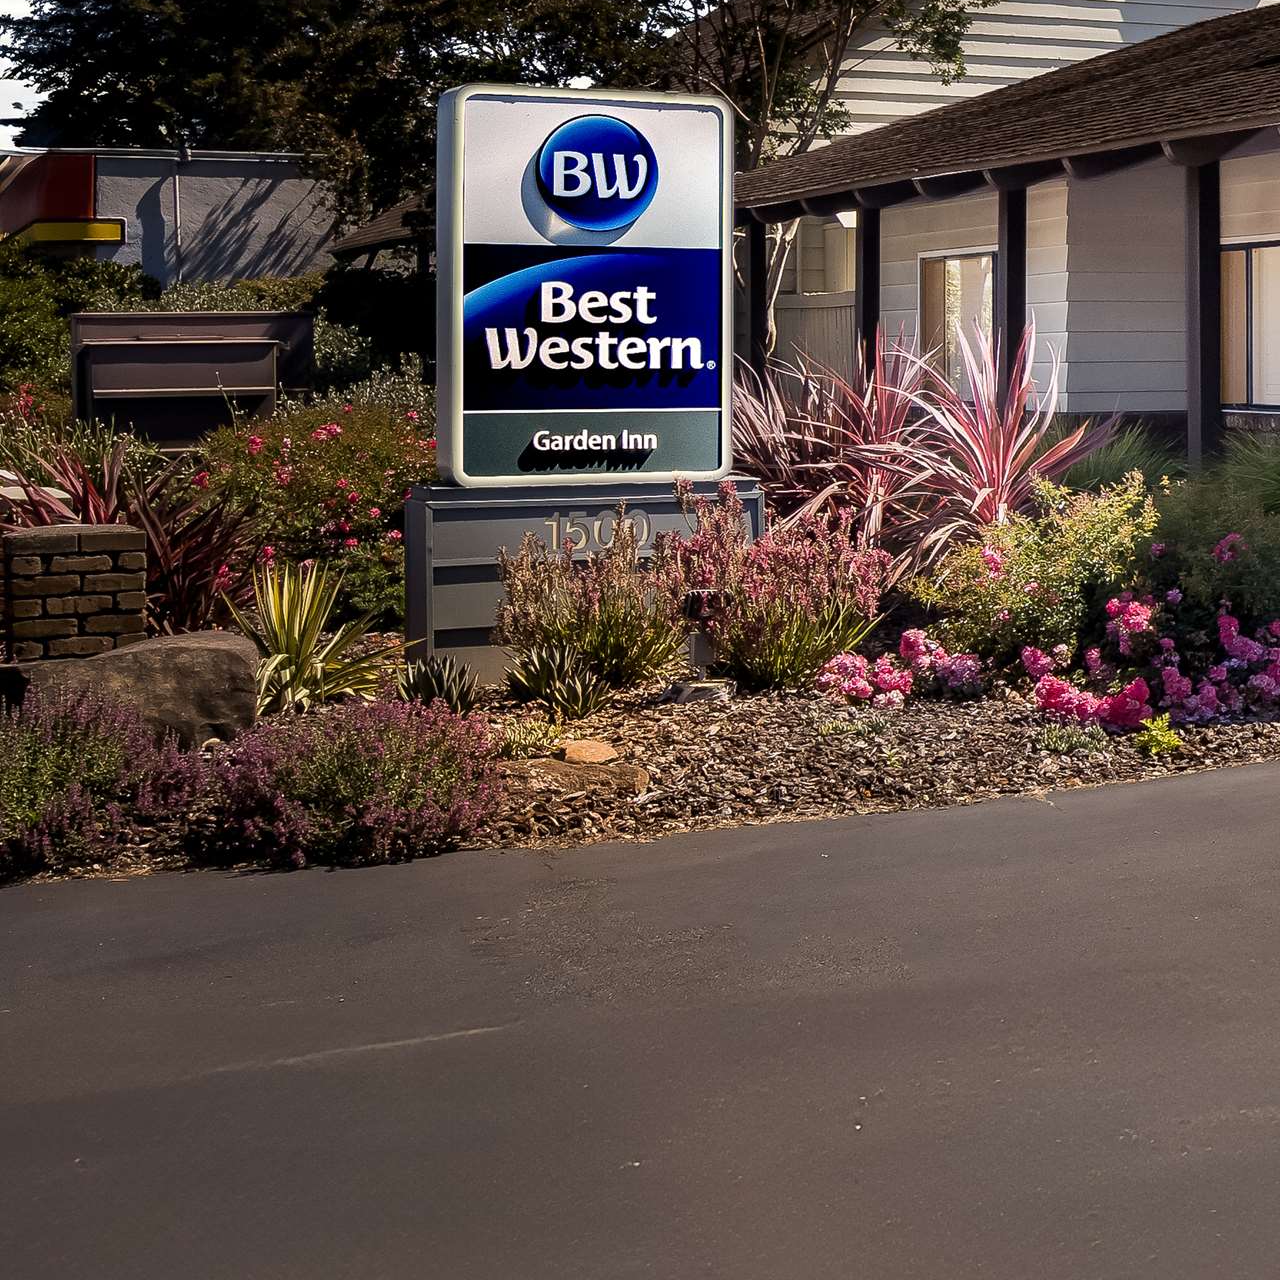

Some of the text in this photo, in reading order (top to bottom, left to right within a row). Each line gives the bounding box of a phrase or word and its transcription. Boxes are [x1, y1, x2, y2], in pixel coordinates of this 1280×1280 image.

[551, 149, 648, 201] BW
[541, 280, 658, 325] Best
[533, 429, 658, 451] Garden Inn
[544, 508, 651, 551] 1500
